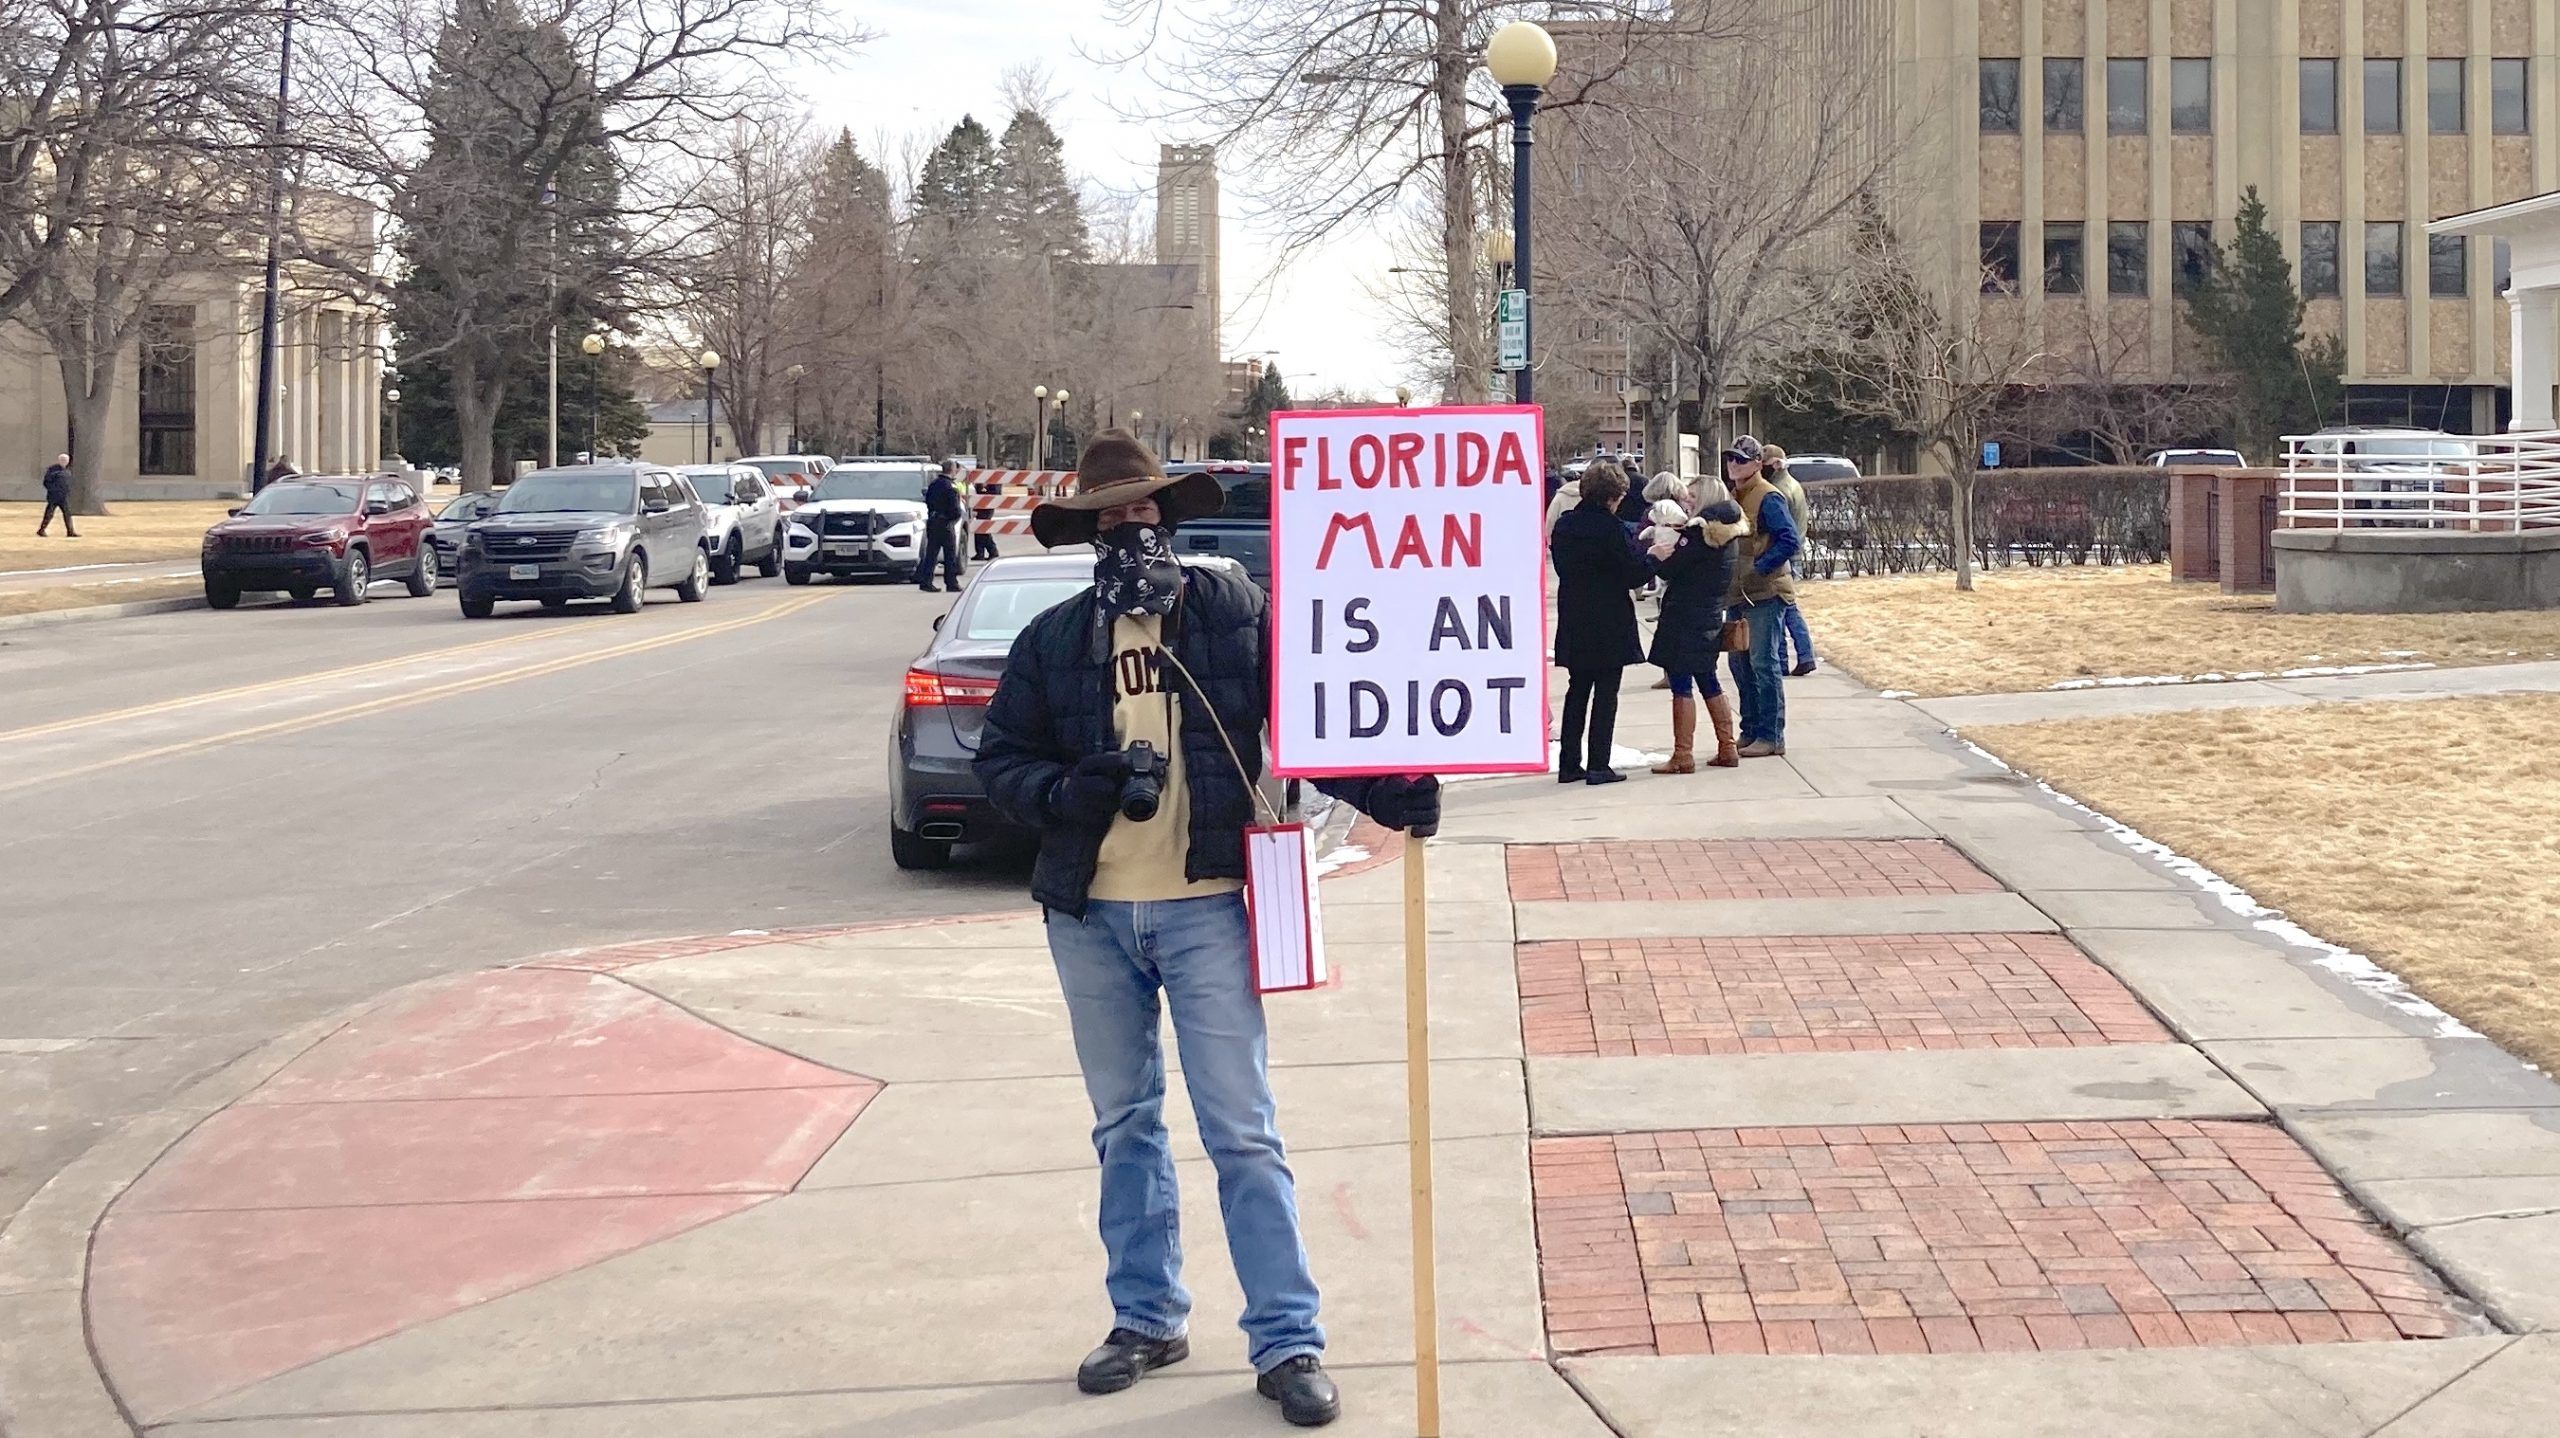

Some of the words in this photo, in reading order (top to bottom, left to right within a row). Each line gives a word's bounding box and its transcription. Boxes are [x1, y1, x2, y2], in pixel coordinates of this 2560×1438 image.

[1501, 298, 1508, 317] 2
[1283, 431, 1532, 491] FLORIDA
[1315, 511, 1482, 570] MAN
[1311, 597, 1380, 654] IS
[1429, 594, 1513, 651] AN
[1113, 646, 1162, 703] OM
[1314, 677, 1527, 739] IDIOT
